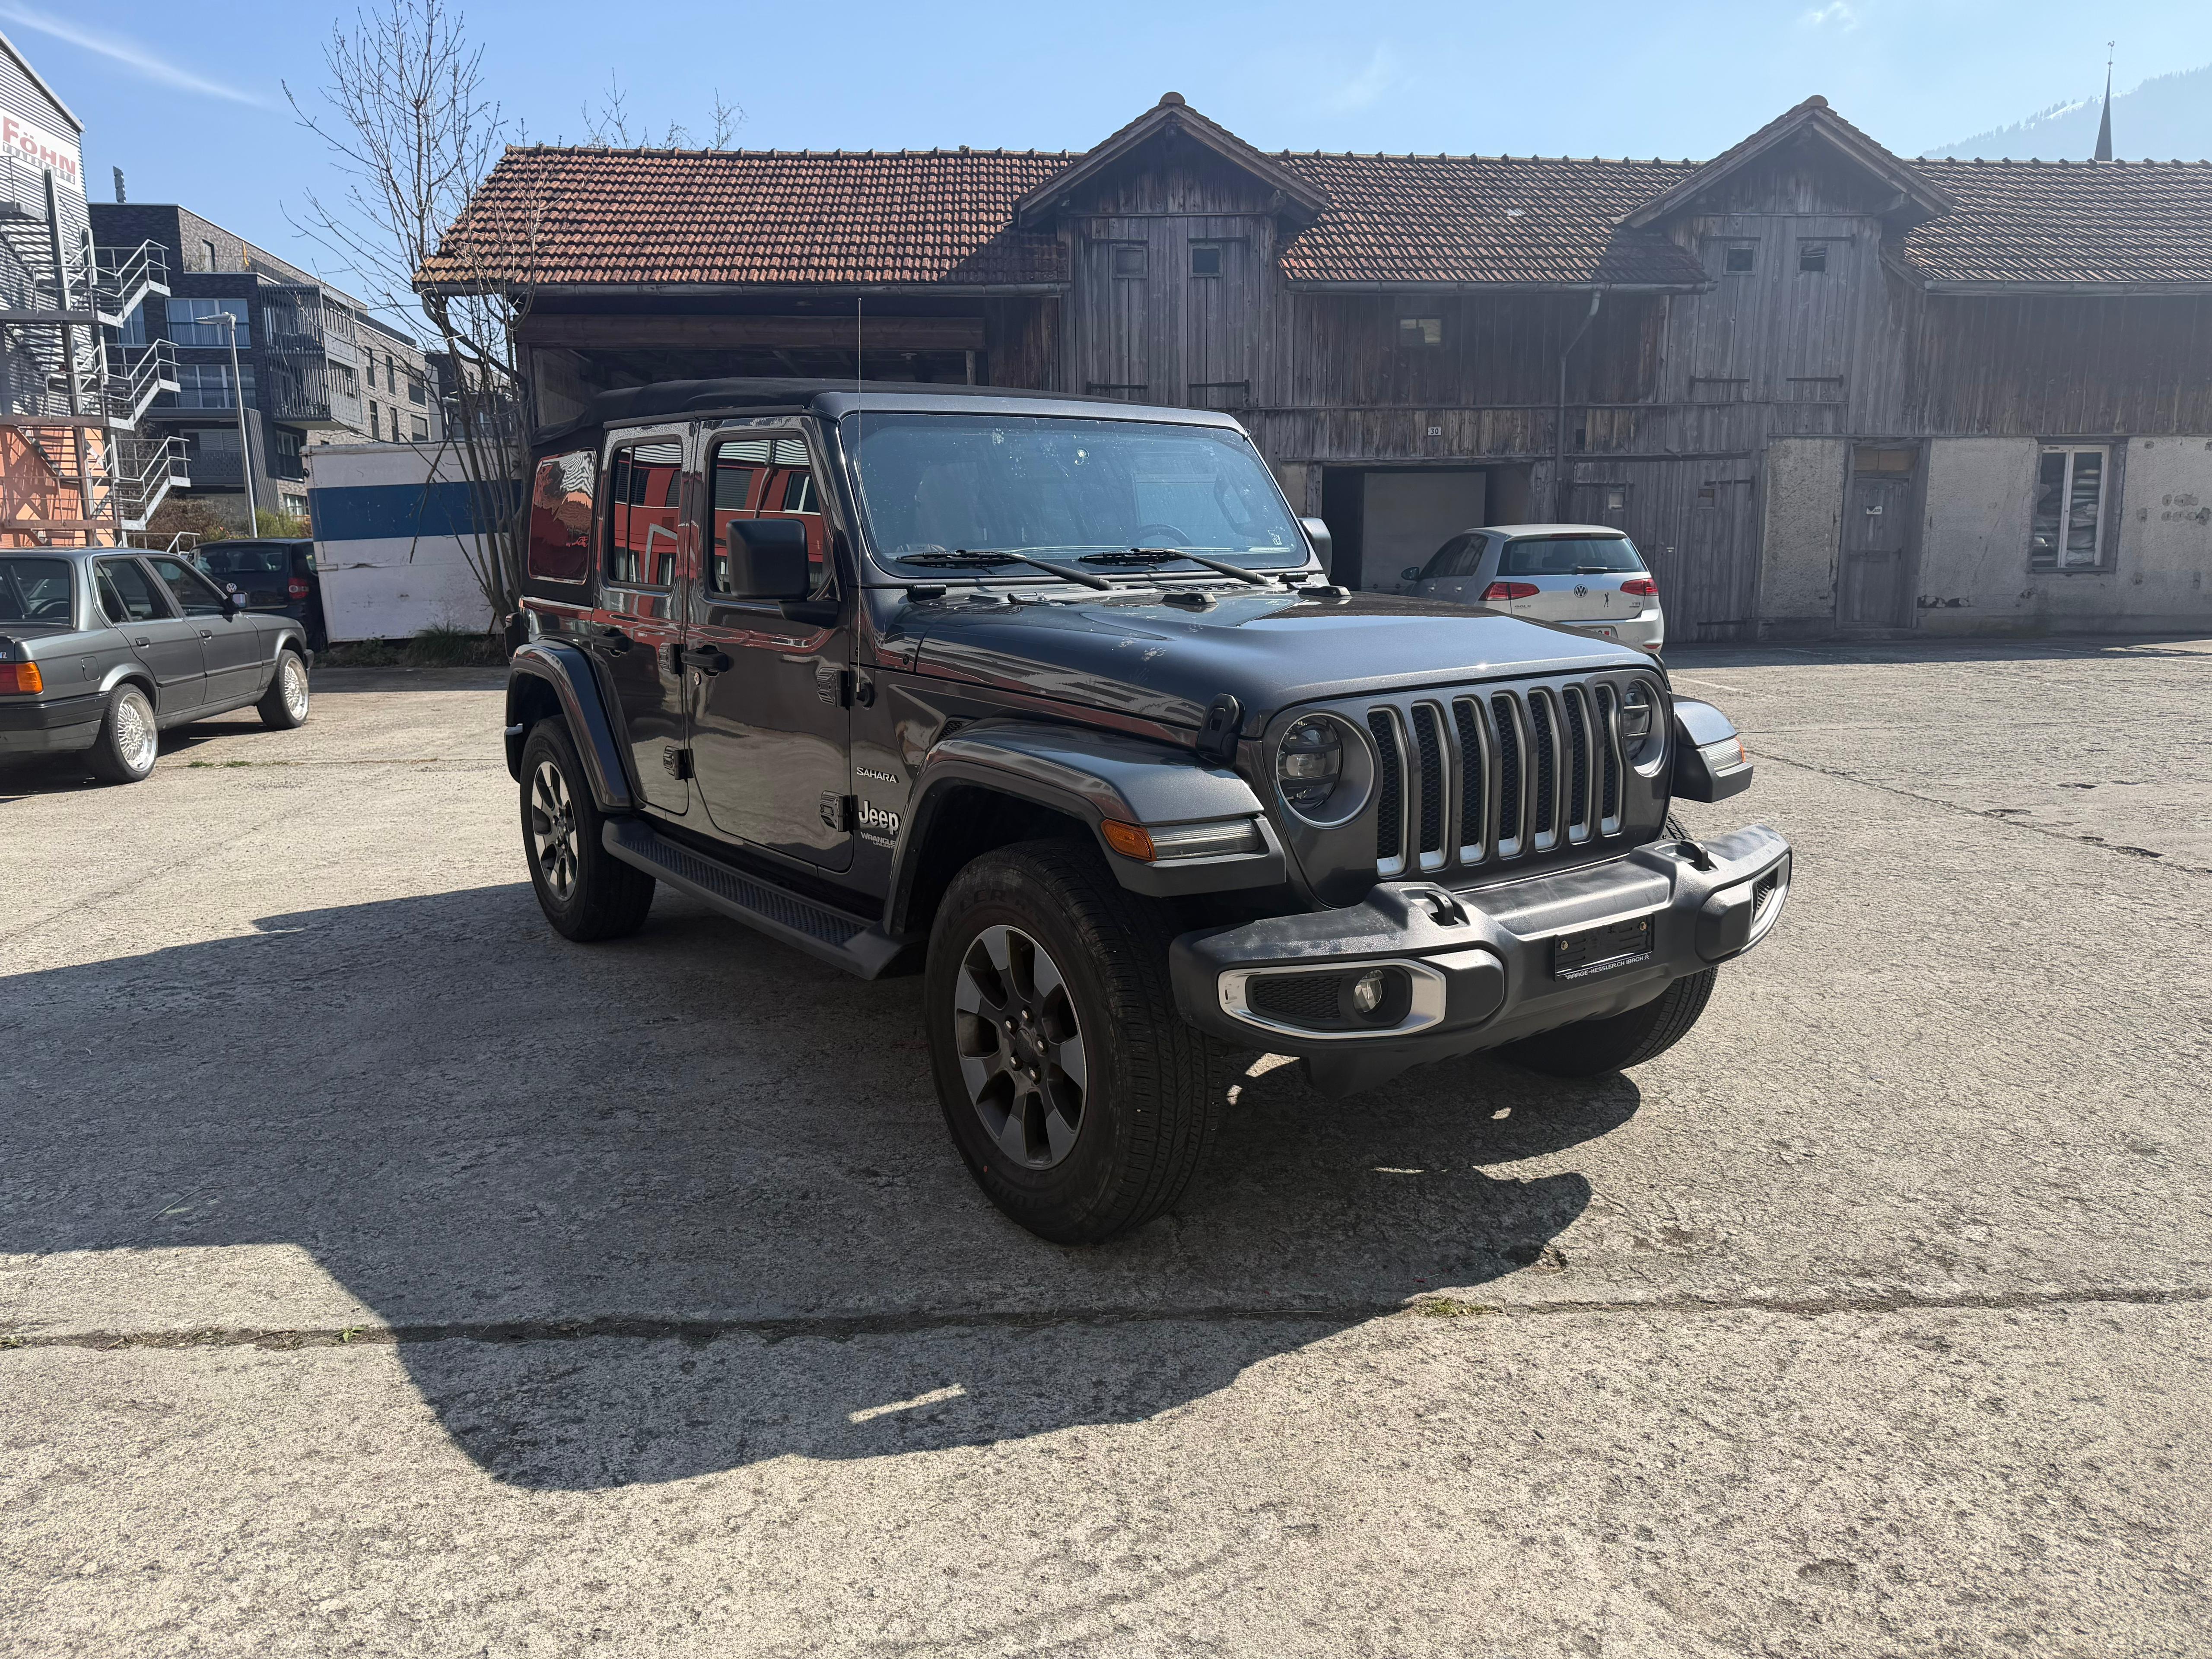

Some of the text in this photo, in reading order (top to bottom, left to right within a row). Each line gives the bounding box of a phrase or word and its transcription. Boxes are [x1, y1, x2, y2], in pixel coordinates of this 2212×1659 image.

[3, 116, 76, 175] FÖHN
[1573, 584, 1588, 598] VW
[857, 767, 897, 783] SAHARA
[858, 801, 899, 835] Jeep
[861, 831, 896, 847] WRANGLE
